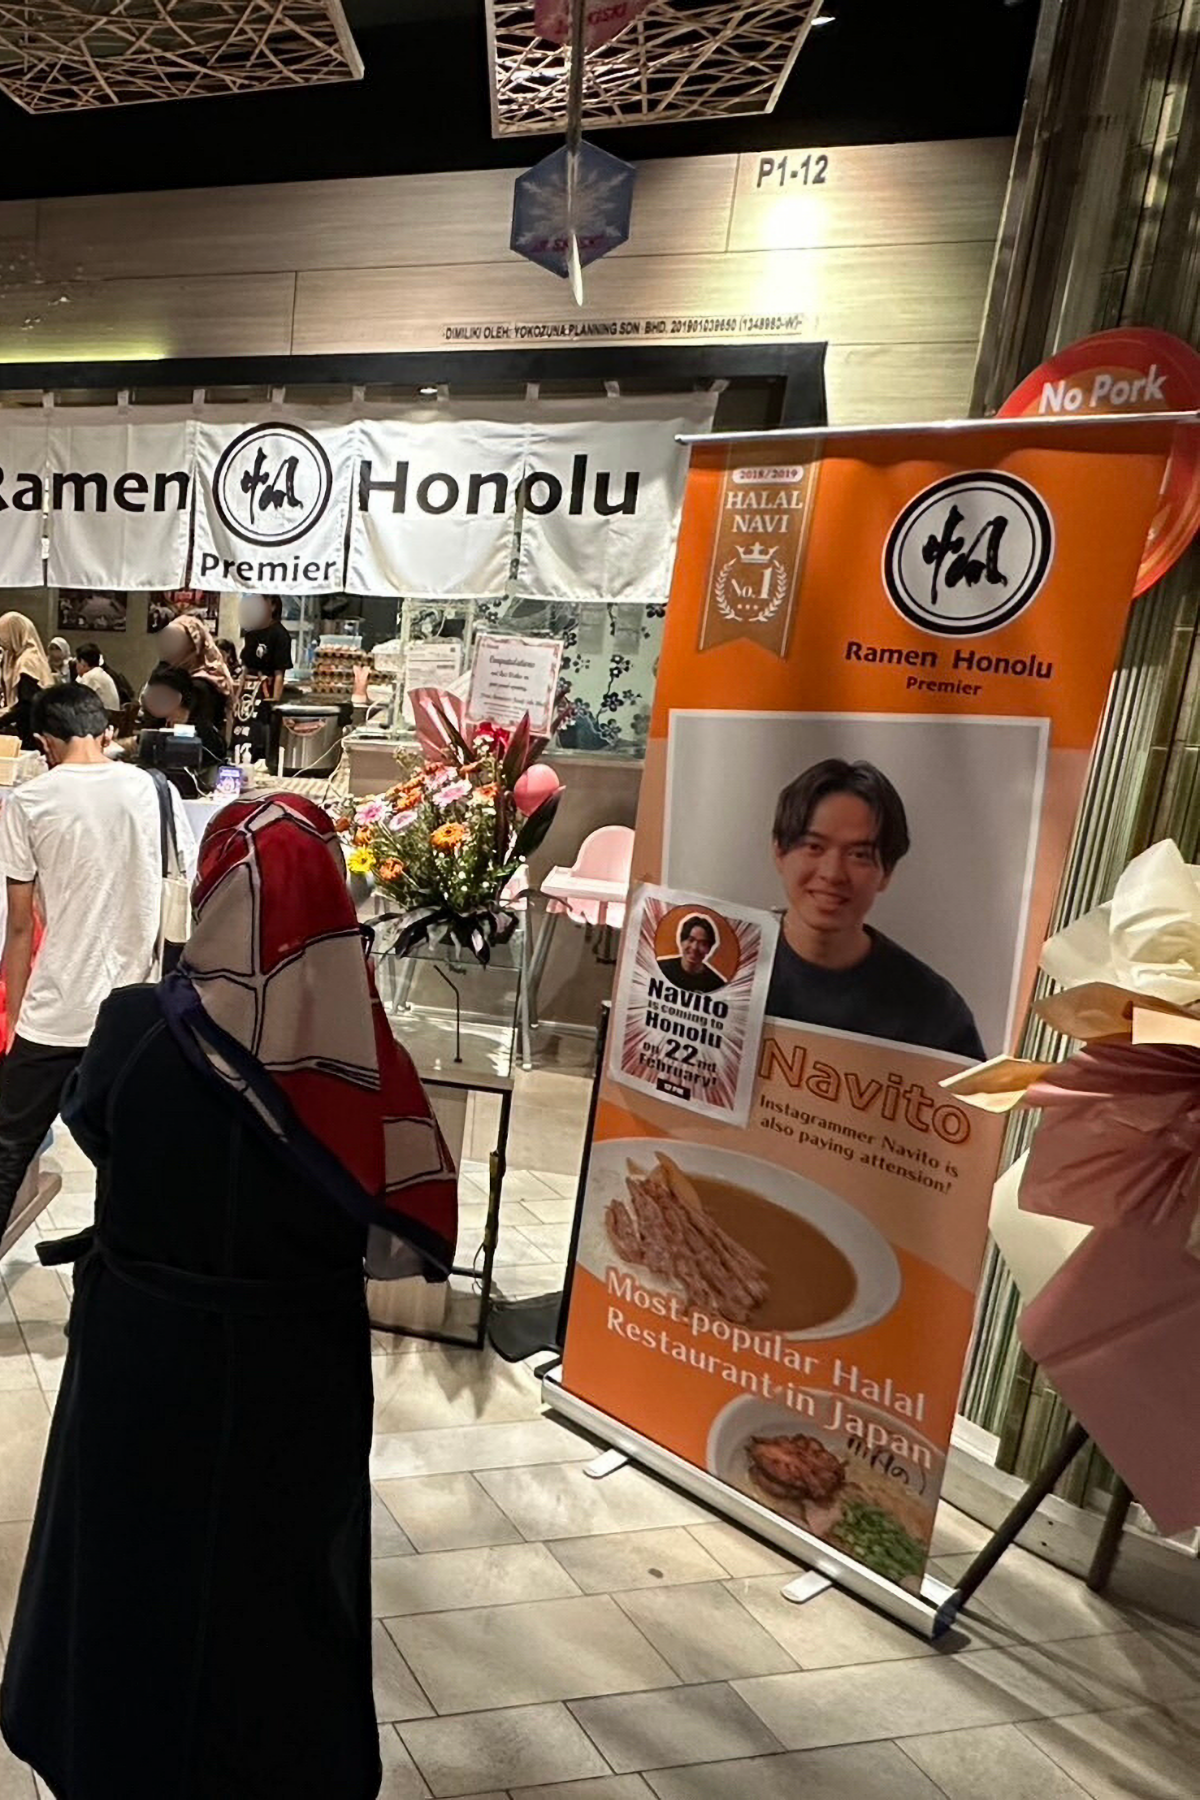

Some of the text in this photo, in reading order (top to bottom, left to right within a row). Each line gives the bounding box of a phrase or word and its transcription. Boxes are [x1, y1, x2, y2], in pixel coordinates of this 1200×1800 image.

[757, 154, 828, 188] P1-12
[514, 323, 565, 339] YOKOZUNA
[568, 322, 618, 337] PLANNING
[1038, 364, 1167, 415] No Pork
[359, 454, 640, 515] Honolu
[739, 467, 798, 480] 2018/2019
[725, 490, 803, 509] HALAL
[731, 514, 790, 533] NAVI
[200, 552, 338, 583] Premier
[845, 641, 1053, 679] Ramen Honolu
[906, 676, 982, 696] Premier
[648, 977, 729, 1019] Navito
[661, 1004, 708, 1027] coming
[710, 1016, 724, 1030] to
[645, 1010, 723, 1049] Honolu
[757, 1037, 971, 1145] Navito
[760, 1094, 959, 1178] Instagrammer Navito is
[760, 1117, 953, 1195] also paying attension!
[607, 1270, 925, 1422] Most popular Halal
[607, 1306, 773, 1399] Restaurant
[785, 1382, 815, 1416] in
[823, 1401, 932, 1470] Japan
